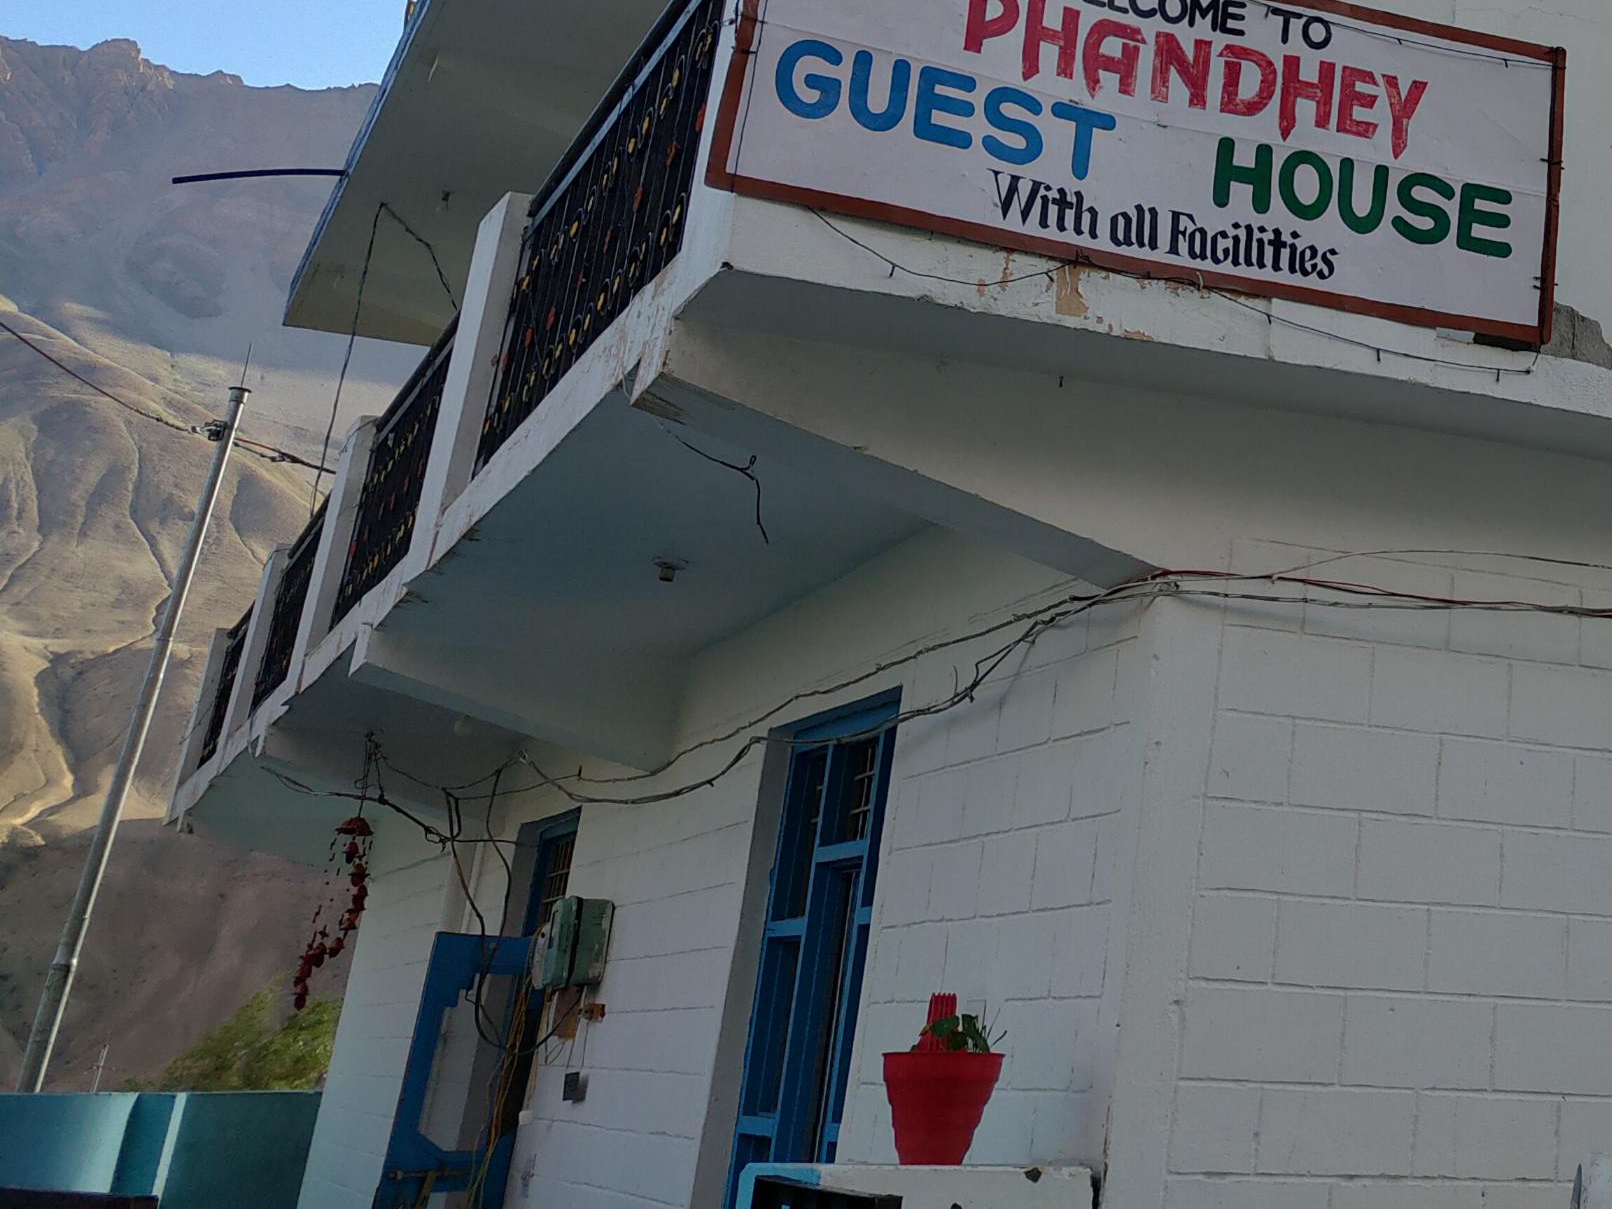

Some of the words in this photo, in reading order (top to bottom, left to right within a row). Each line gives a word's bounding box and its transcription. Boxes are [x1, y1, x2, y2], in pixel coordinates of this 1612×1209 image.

[1270, 7, 1332, 50] TO
[775, 39, 1117, 181] GUEST
[988, 169, 1099, 240] With
[1109, 203, 1159, 252] all
[1166, 209, 1339, 282] Facilities
[1213, 136, 1514, 259] HOUSE
